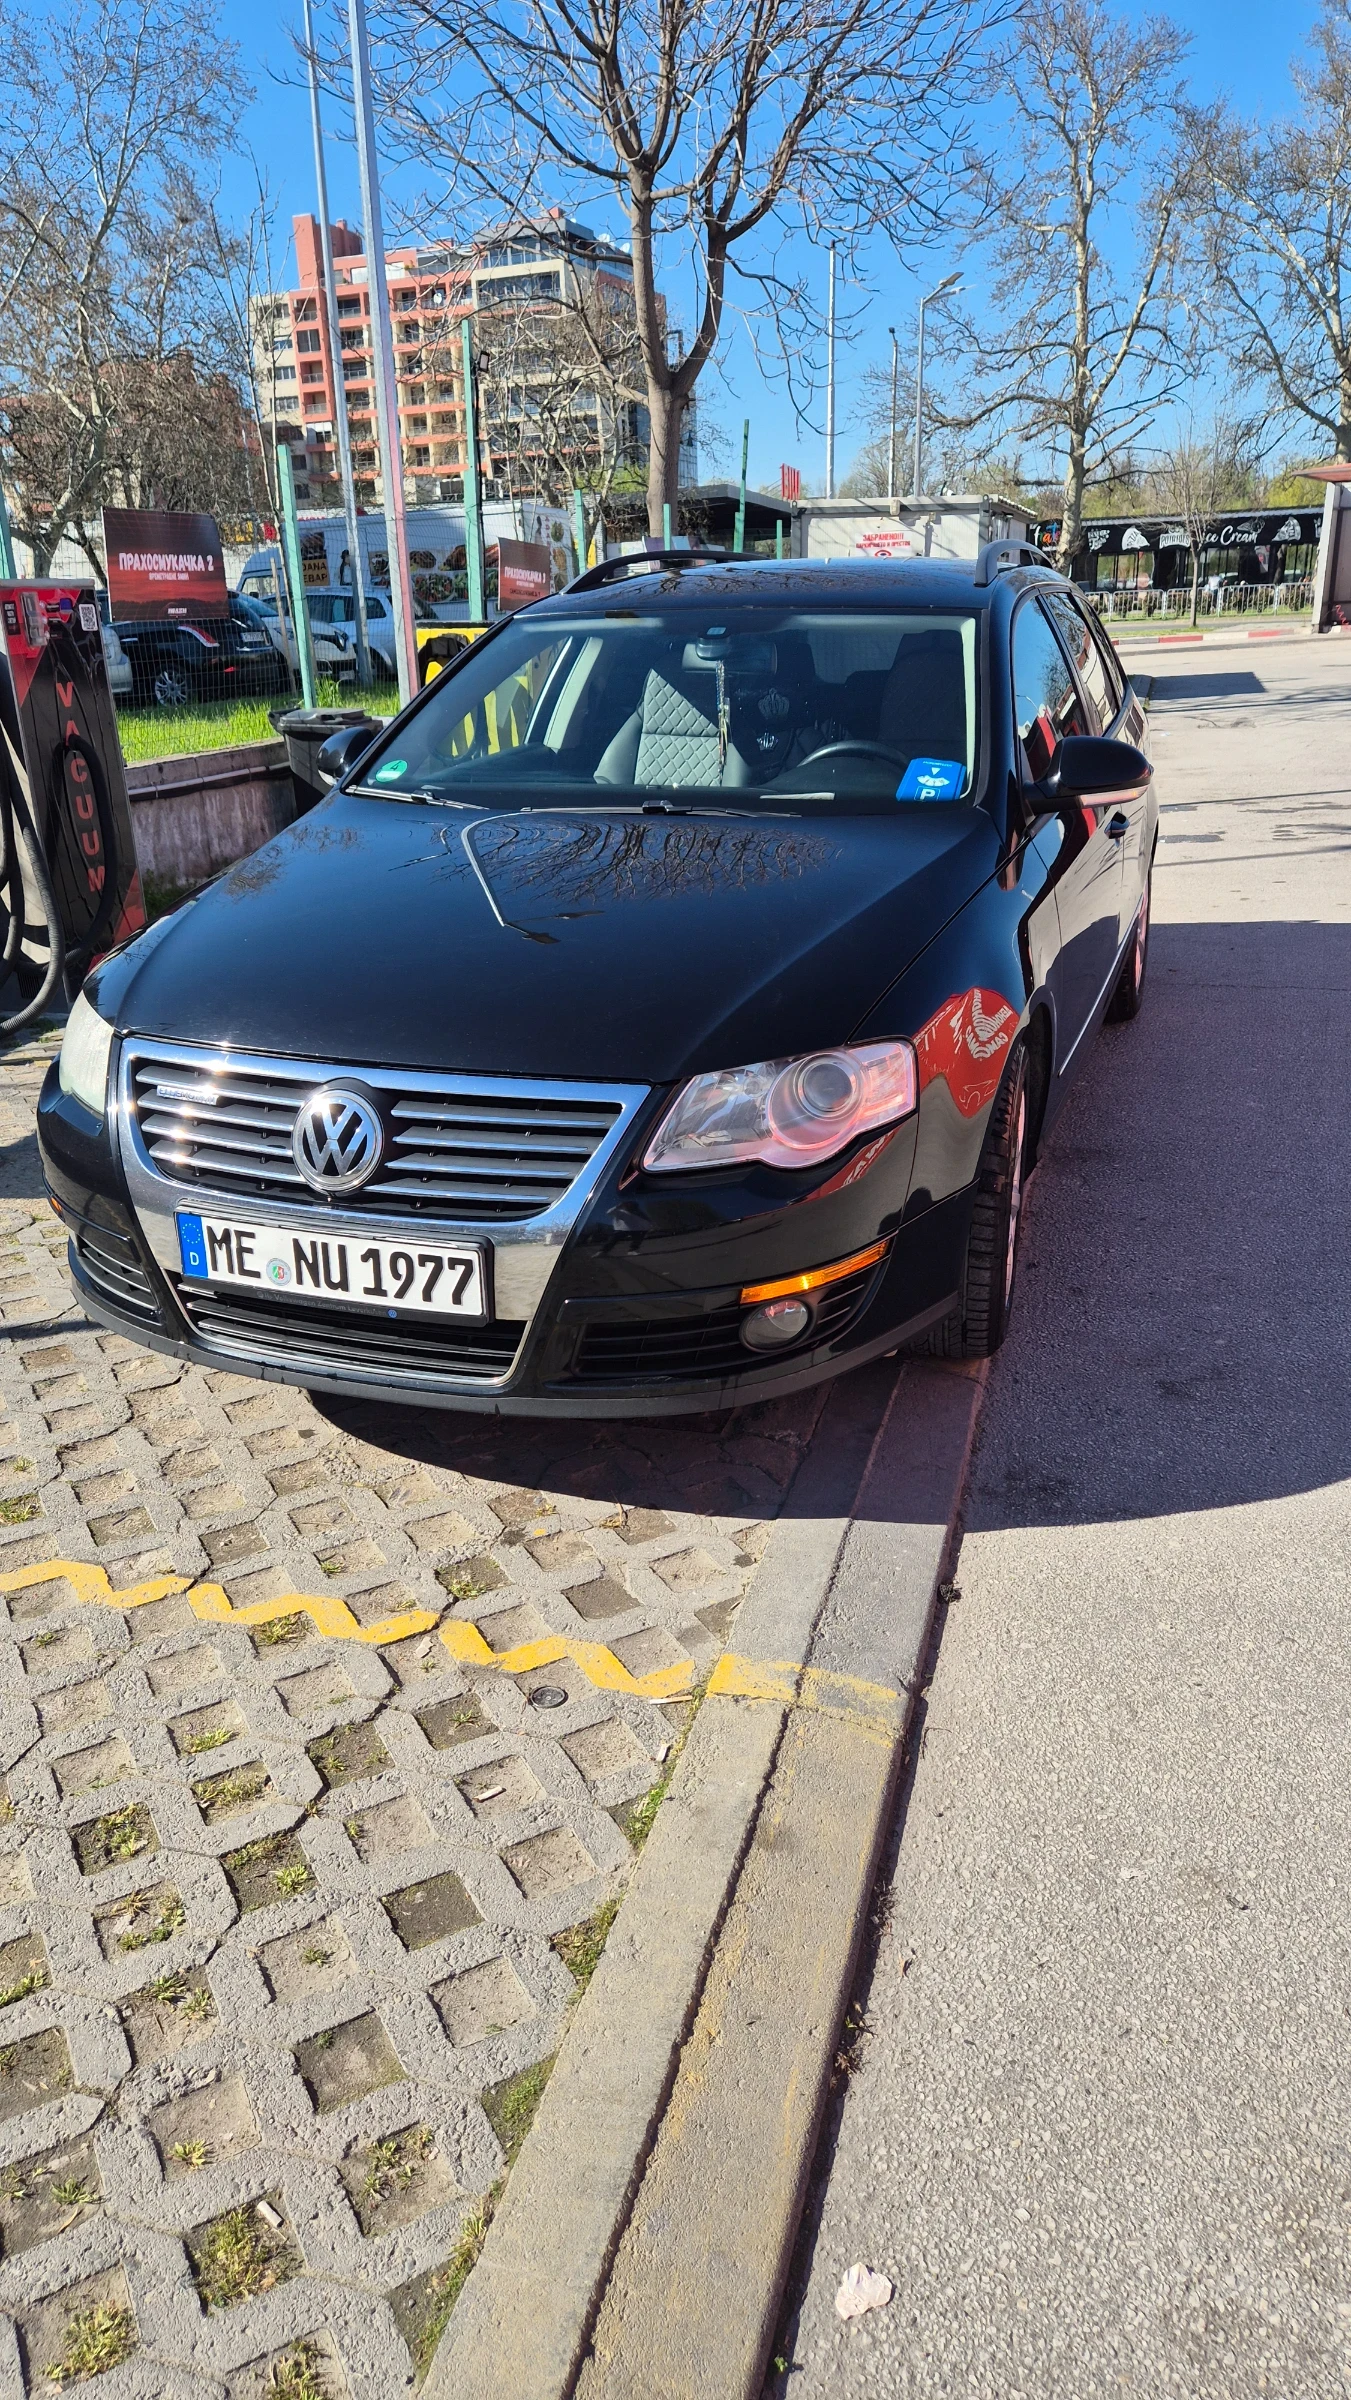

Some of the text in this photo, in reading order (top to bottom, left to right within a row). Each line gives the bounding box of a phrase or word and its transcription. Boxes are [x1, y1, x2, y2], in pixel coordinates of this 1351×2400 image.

[1220, 525, 1258, 545] Cream
[118, 552, 215, 572] ПРАХОСМУКАЧКА 2
[303, 573, 327, 583] EBAP
[56, 681, 105, 892] VACUUM
[919, 788, 936, 800] P
[189, 1250, 199, 1266] D
[205, 1225, 262, 1279] ME
[292, 1238, 350, 1292] NU
[360, 1247, 475, 1306] 1977
[317, 1301, 347, 1311] Zentrum
